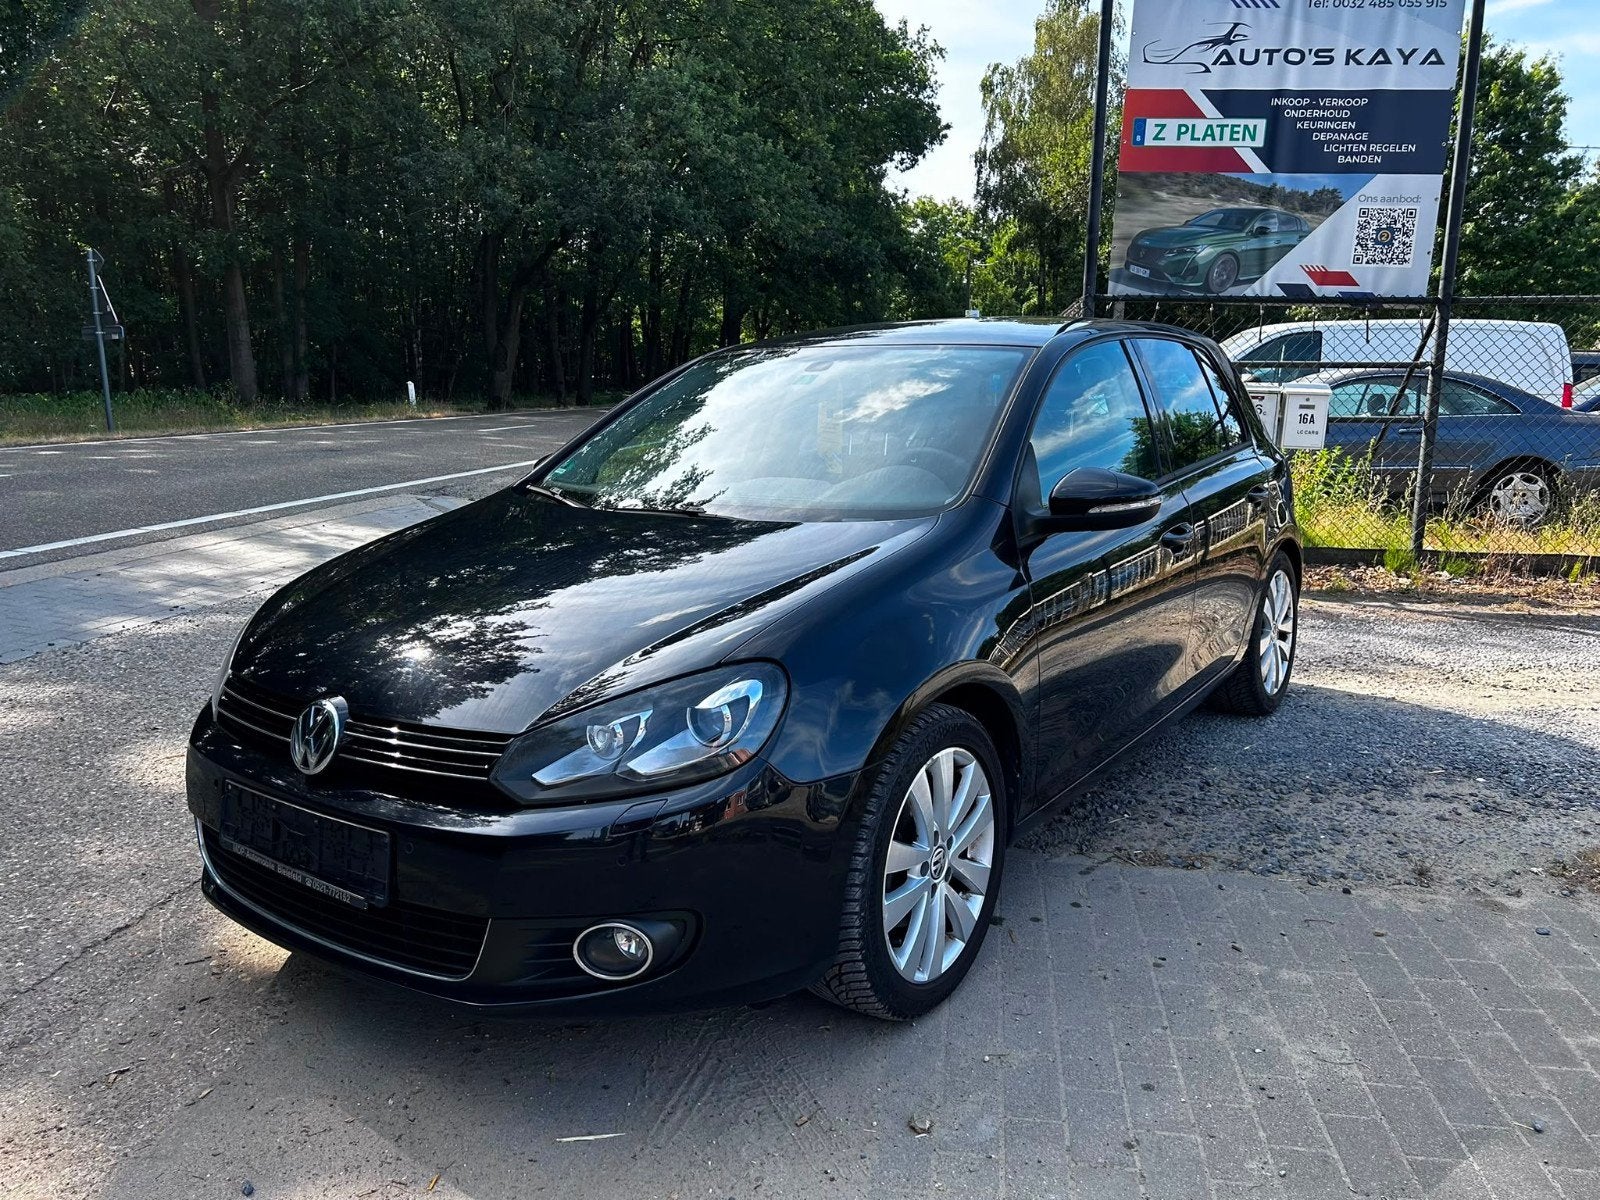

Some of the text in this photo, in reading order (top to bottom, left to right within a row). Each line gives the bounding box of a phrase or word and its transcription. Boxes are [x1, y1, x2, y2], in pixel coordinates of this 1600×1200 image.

[1308, 0, 1447, 8] Tel: 0032 485 055 915
[1211, 48, 1446, 66] AUTO'S KAYA
[1270, 97, 1310, 106] INKOOP
[1318, 98, 1369, 106] VERKOOP
[1284, 109, 1351, 118] ONDERHOUD
[1296, 121, 1356, 129] KEURINGEN
[1152, 123, 1258, 142] Z PLATEN
[1312, 132, 1369, 140] DEPANAGE
[1323, 144, 1416, 152] LICHTEN REGELEN
[1337, 155, 1382, 163] BANDEN
[1358, 194, 1421, 203] Ons aanbod:
[1298, 413, 1315, 424] 16A
